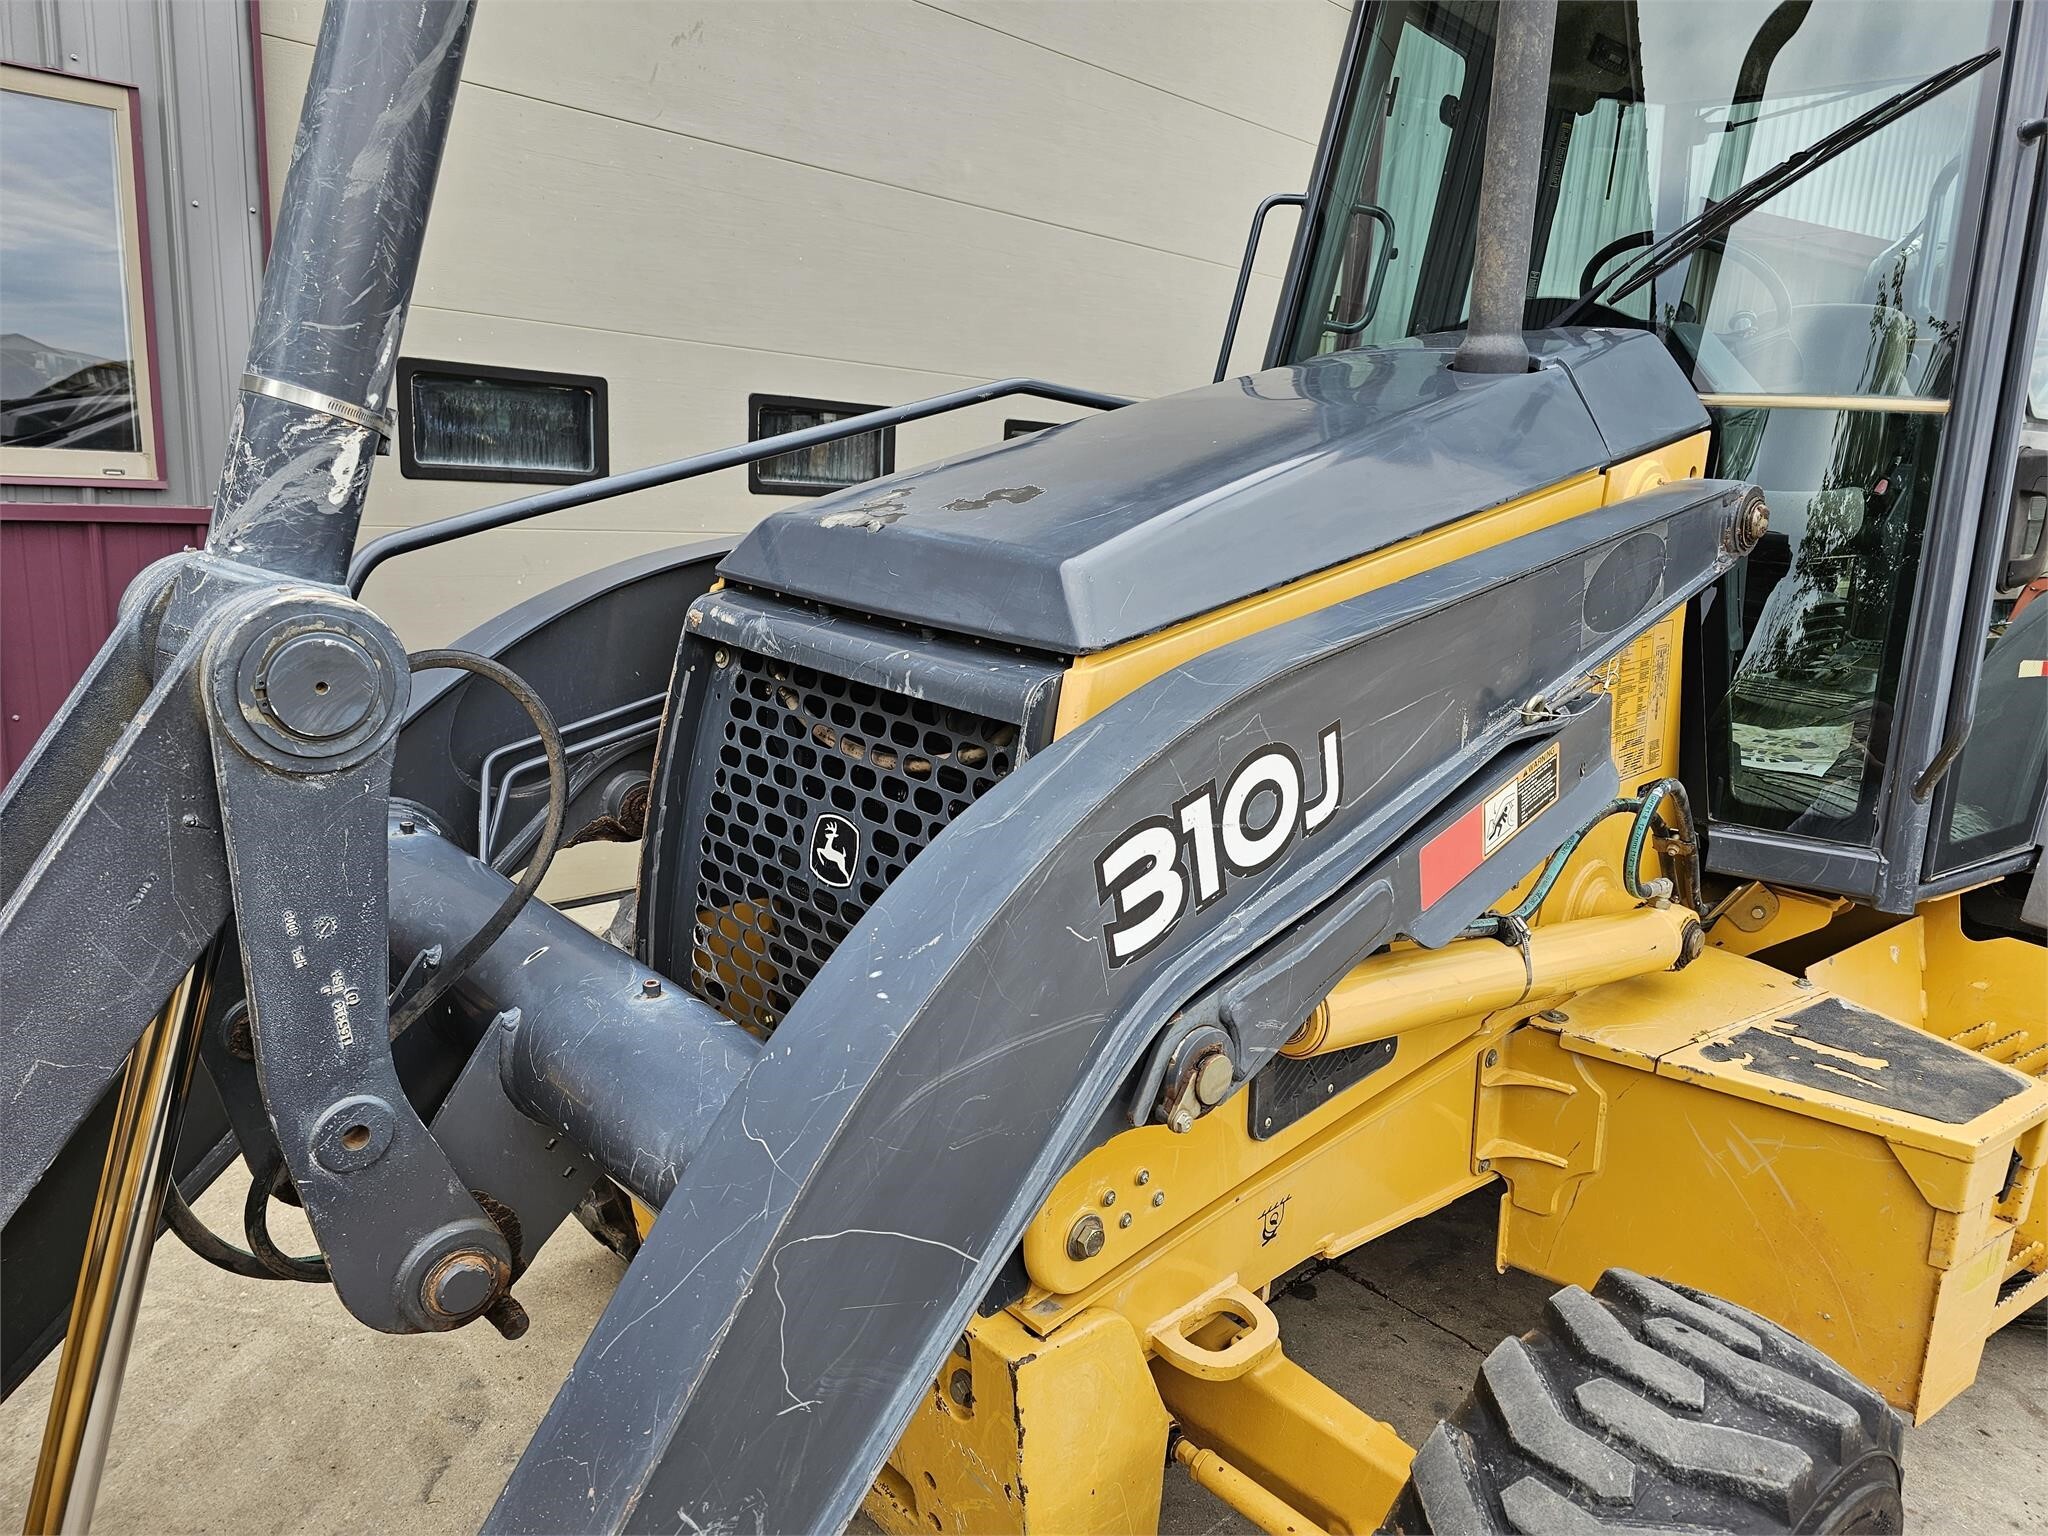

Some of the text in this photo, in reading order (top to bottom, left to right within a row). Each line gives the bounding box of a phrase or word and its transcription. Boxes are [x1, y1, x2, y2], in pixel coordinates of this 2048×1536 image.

[1528, 747, 1555, 771] WARNING
[1094, 720, 1343, 969] 310J
[331, 969, 346, 995] USA
